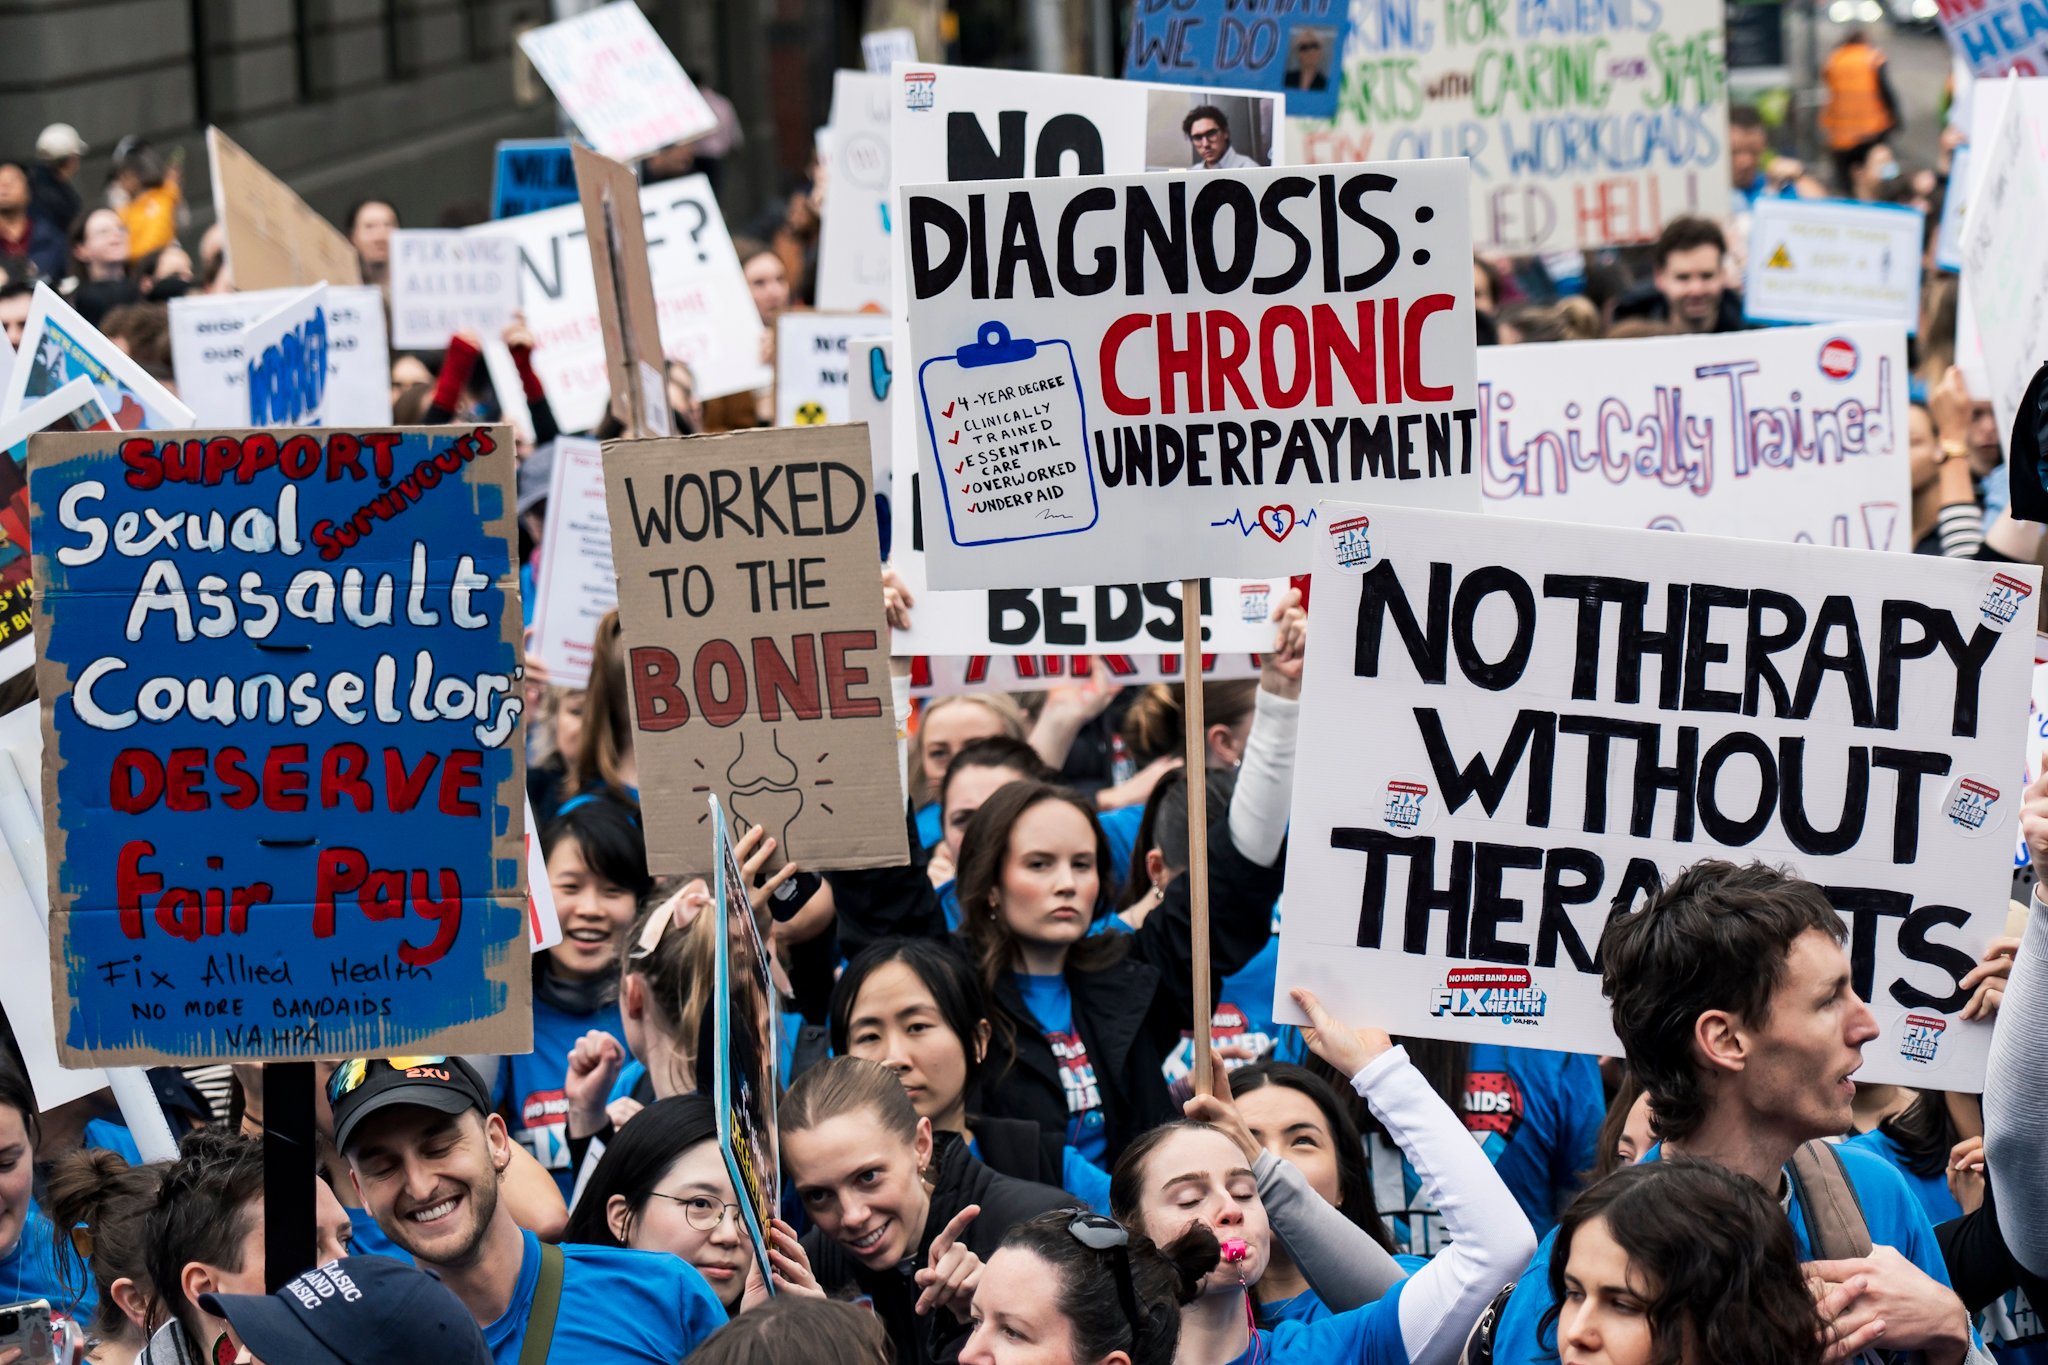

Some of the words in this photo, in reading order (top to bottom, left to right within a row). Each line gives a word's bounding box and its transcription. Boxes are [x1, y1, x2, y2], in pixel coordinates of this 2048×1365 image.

[1136, 18, 1203, 69] WE
[1215, 16, 1280, 71] DO
[1473, 39, 1612, 117] CARING
[947, 110, 1105, 182] NO
[1387, 120, 1492, 179] OUR
[1501, 107, 1723, 177] WORKLOADS
[908, 172, 1435, 300] DIAGNOSIS:
[1099, 293, 1457, 416] CHRONIC
[1018, 375, 1065, 396] DEGREE
[964, 402, 1050, 432] CLINICALLY
[1477, 383, 1714, 500] linically
[1695, 355, 1895, 478] Trained
[973, 419, 1053, 444] TRAINED
[120, 432, 402, 491] SUPPORT
[965, 435, 1061, 467] ESSENTIAL
[1094, 408, 1477, 488] UNDERPAYMENT
[972, 461, 1077, 494] OVERWORKED
[982, 459, 1021, 476] CARE
[311, 426, 498, 562] Survivours
[624, 460, 867, 548] WORKED
[975, 485, 1064, 513] UNDERPAID
[57, 480, 304, 568] Sexual
[1272, 511, 1284, 533] $
[1332, 527, 1368, 548] FIX
[1336, 542, 1367, 556] ALLIED
[1336, 549, 1368, 564] HEALTH
[125, 540, 490, 643] Assault
[649, 563, 715, 618] TO
[736, 557, 831, 613] THE
[1987, 581, 2026, 608] FIX
[988, 580, 1214, 645] BEDS!
[1981, 602, 2011, 620] HEALTH
[1984, 596, 2015, 613] ALLIED
[1353, 558, 1537, 691] NO
[1543, 572, 2003, 738] THERAPY
[629, 629, 883, 732] BONE
[109, 742, 484, 817] DESERVE
[1412, 706, 1953, 864] WITHOUT
[1385, 803, 1418, 816] ALLIED
[1387, 790, 1424, 809] FIX
[1952, 801, 1984, 818] ALLIED
[1956, 788, 1993, 813] FIX
[1384, 813, 1416, 824] HEALTH
[1949, 807, 1981, 825] HEALTH
[312, 847, 462, 967] Pay
[1330, 826, 1980, 1016] THERATS
[97, 954, 176, 990] Fix
[201, 952, 294, 988] Allied
[331, 954, 433, 987] Health
[1461, 974, 1484, 982] MORE
[1485, 974, 1507, 982] BAND
[132, 1002, 166, 1020] NO
[185, 999, 244, 1017] MORE
[1430, 988, 1490, 1014] FIX
[1488, 988, 1543, 1001] ALLIED
[1486, 1001, 1542, 1013] HEALTH
[1513, 1017, 1539, 1026] VAHPA
[1904, 1024, 1942, 1043] FIX
[1901, 1045, 1933, 1059] HEALTH
[1902, 1037, 1935, 1050] ALLIED
[405, 1067, 450, 1081] 2XU
[524, 1101, 544, 1119] NO
[543, 1098, 570, 1115] MO
[1463, 1090, 1512, 1113] AIDS
